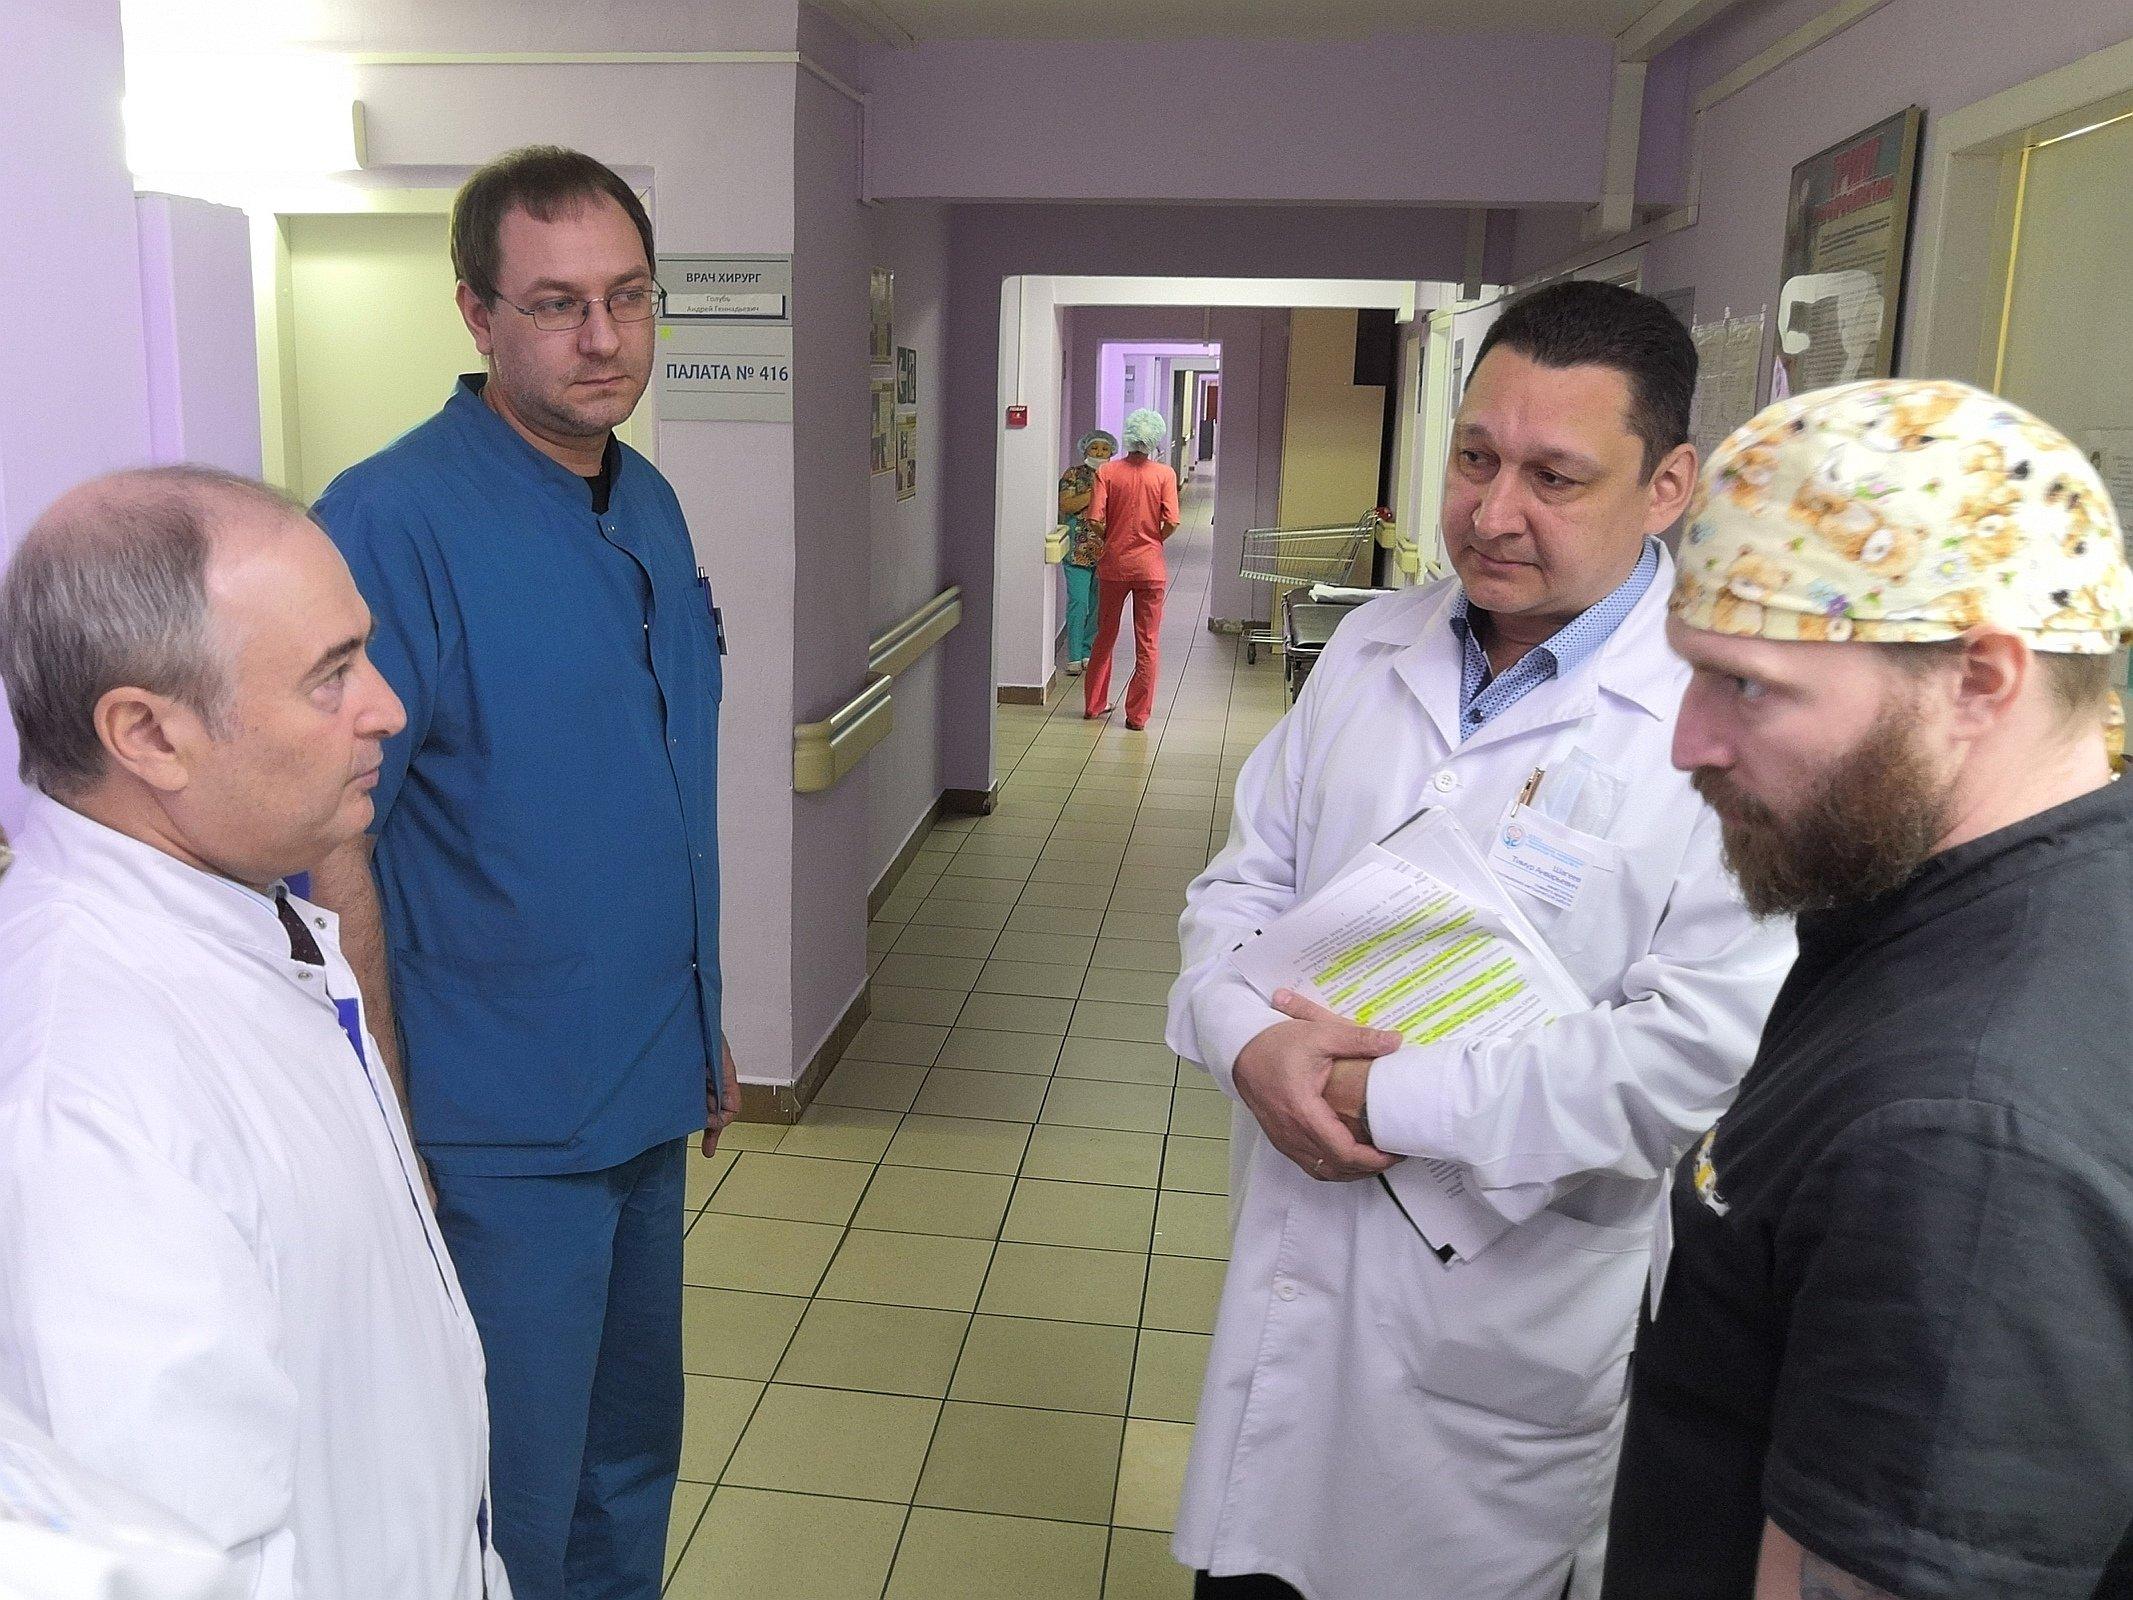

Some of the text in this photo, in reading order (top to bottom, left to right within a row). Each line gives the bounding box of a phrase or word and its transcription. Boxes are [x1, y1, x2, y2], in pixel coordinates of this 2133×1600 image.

[686, 272, 762, 283] ВРАЧ ХИРУРГ
[686, 305, 713, 313] Андрей
[666, 363, 789, 381] ПАЛАТА № 416
